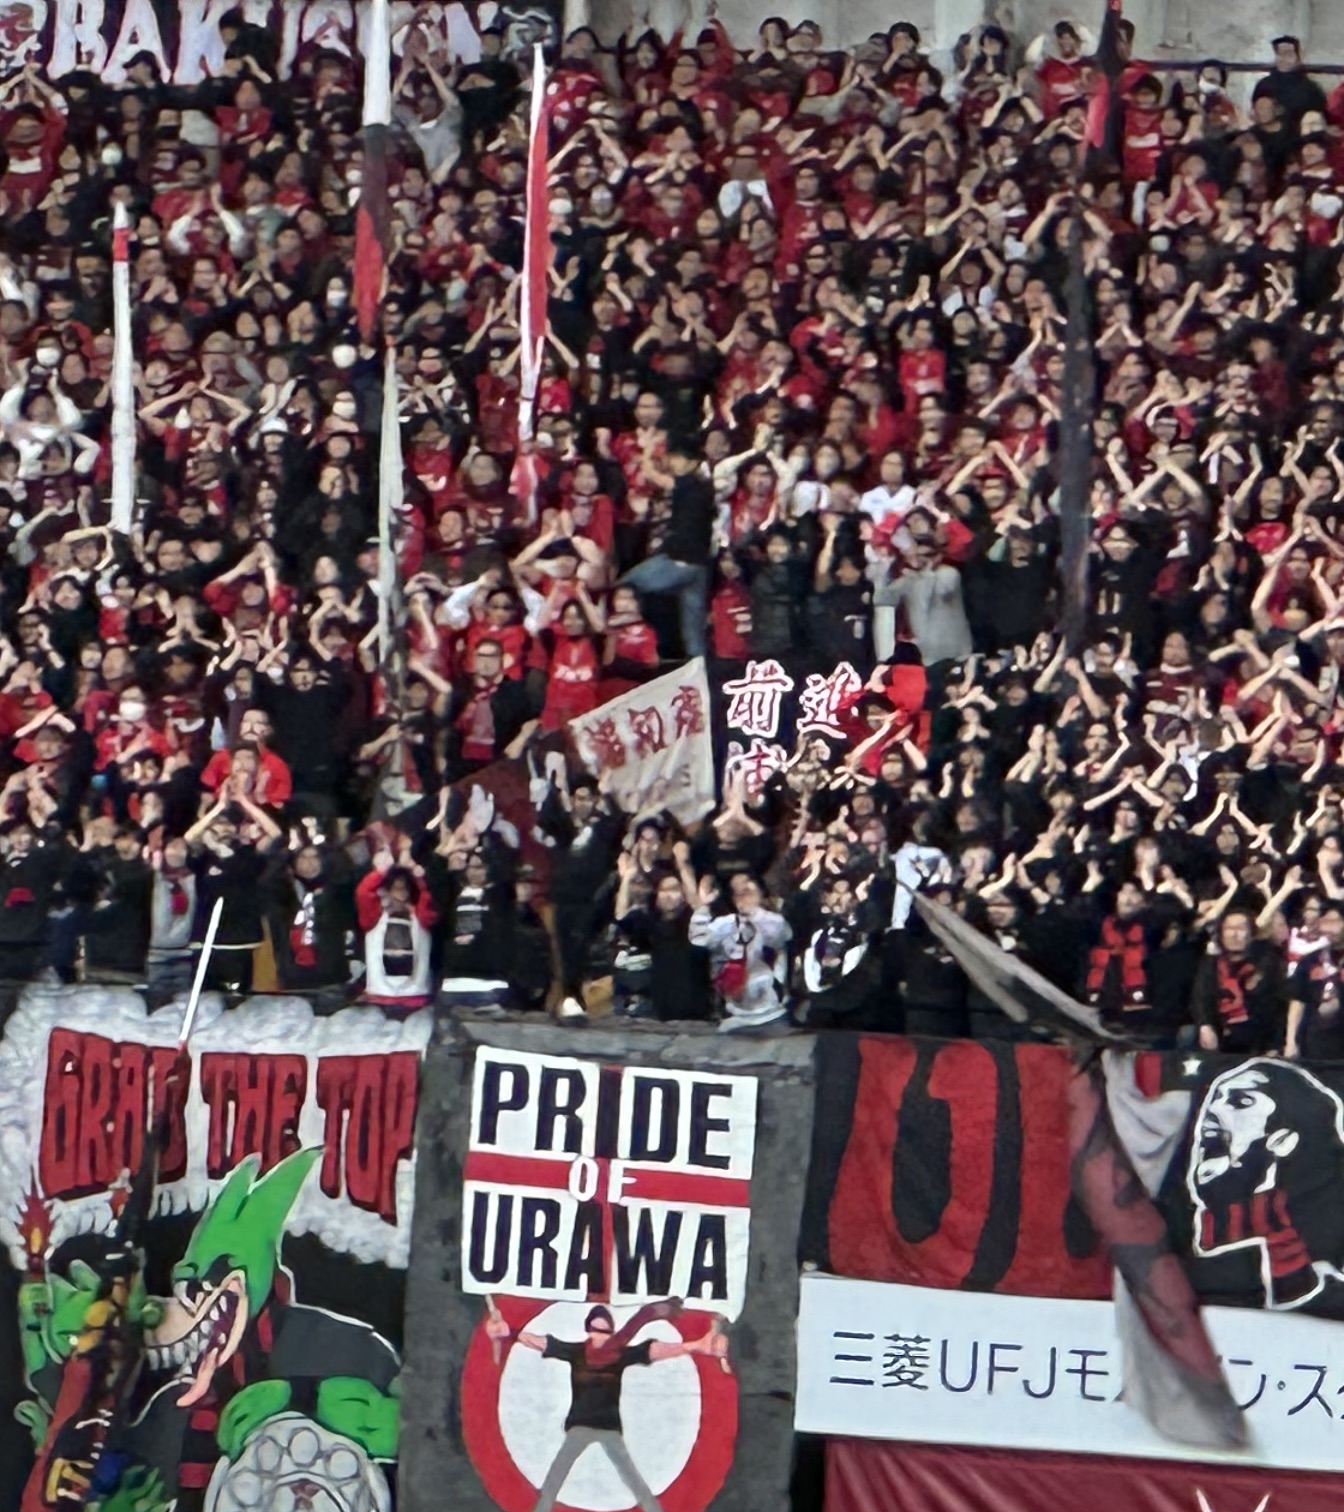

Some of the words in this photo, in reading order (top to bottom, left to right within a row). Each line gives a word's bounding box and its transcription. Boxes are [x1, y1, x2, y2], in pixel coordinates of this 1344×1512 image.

[200, 1051, 308, 1182] THE
[315, 1049, 422, 1228] TOP
[477, 1060, 733, 1171] PRIDE
[568, 1153, 638, 1204] OF
[468, 1190, 729, 1301] URAWA
